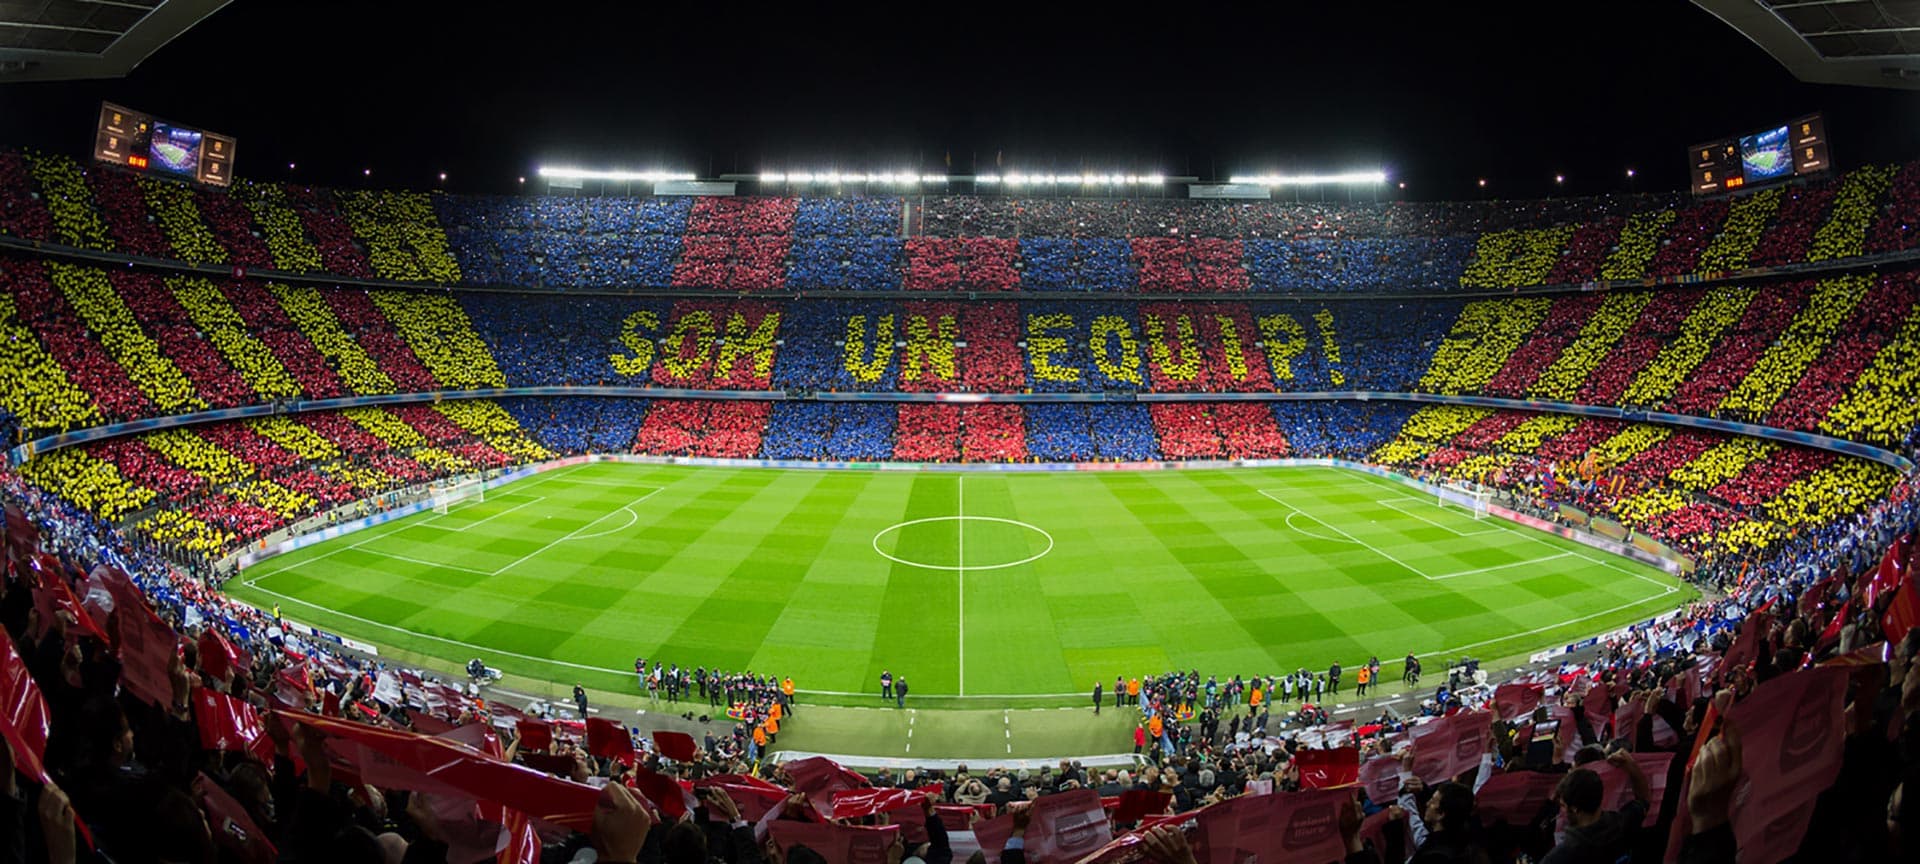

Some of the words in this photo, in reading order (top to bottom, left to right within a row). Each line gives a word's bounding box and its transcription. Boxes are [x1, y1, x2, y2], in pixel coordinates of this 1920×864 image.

[608, 310, 780, 379] SOM
[843, 313, 956, 382] UN
[1026, 309, 1346, 385] EQUIP!
